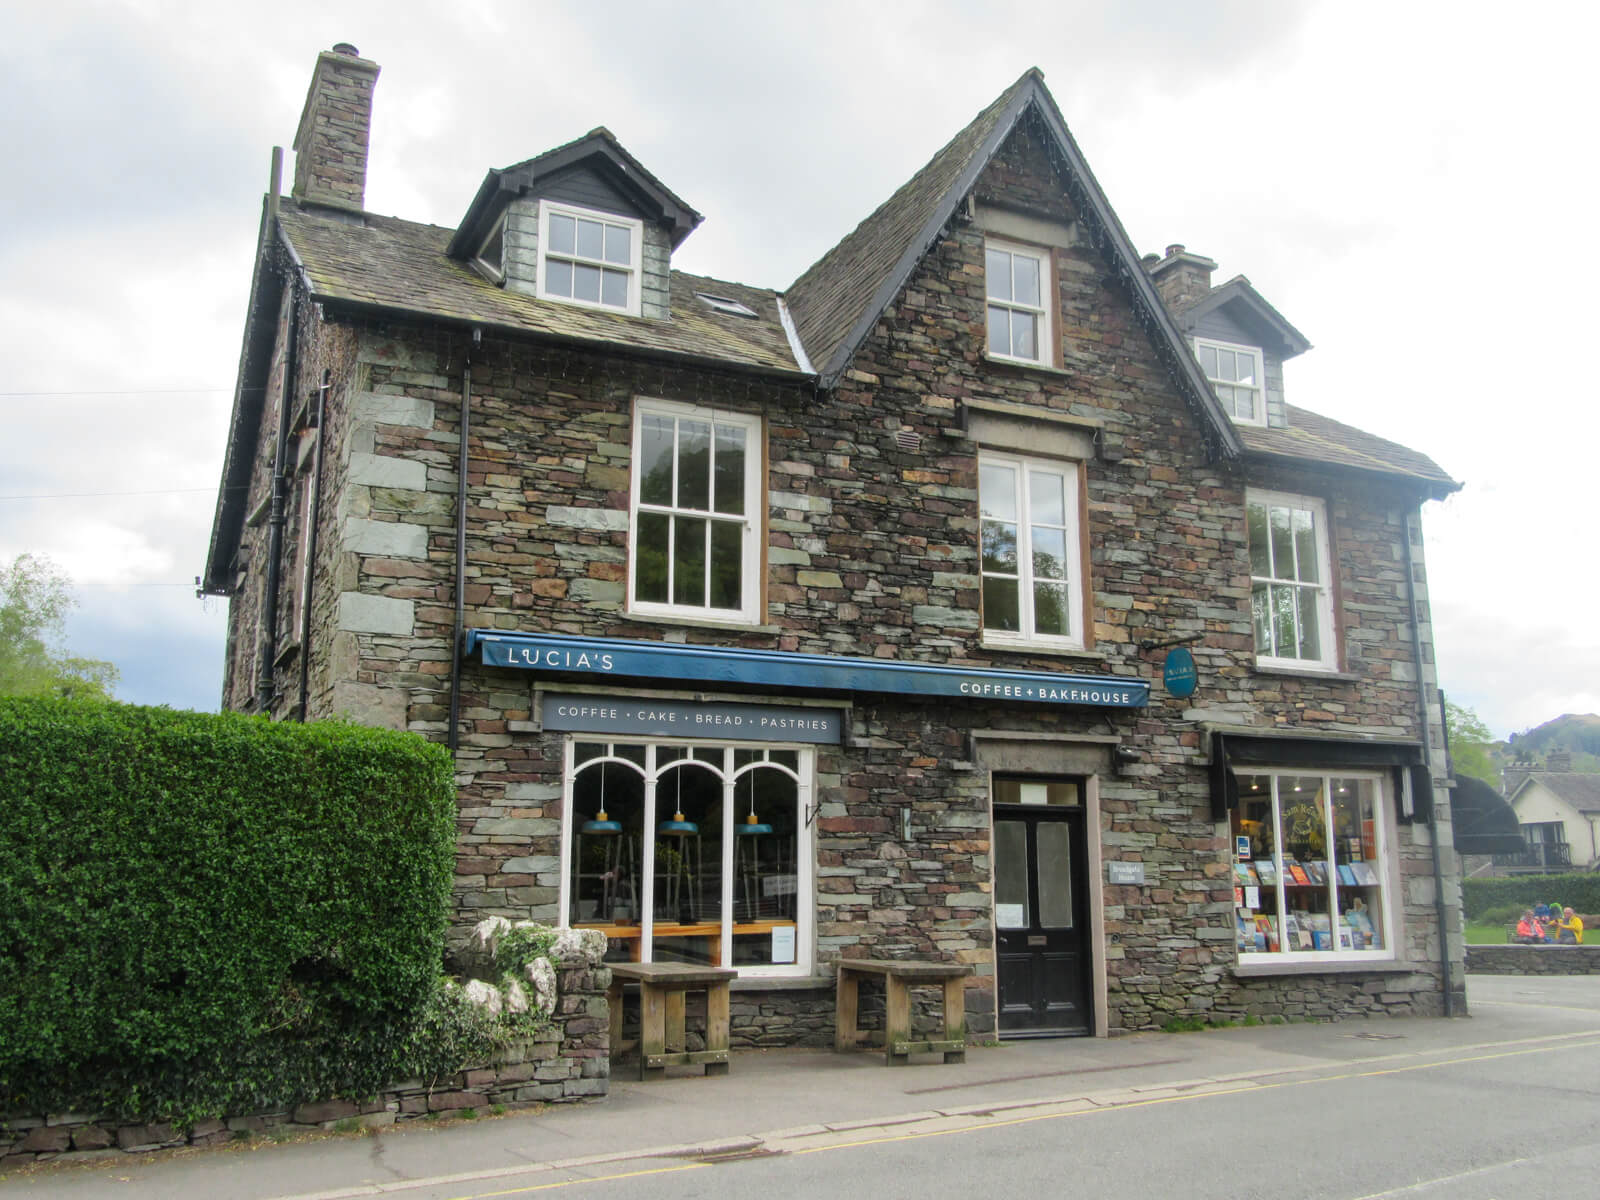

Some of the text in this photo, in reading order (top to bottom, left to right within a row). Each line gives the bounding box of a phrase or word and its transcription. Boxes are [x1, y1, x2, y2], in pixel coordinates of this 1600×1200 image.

[508, 647, 613, 670] LUCIA'S
[960, 683, 1022, 697] COFFEE
[558, 706, 828, 730] COFFEE CAKE BREAD PASTRIES
